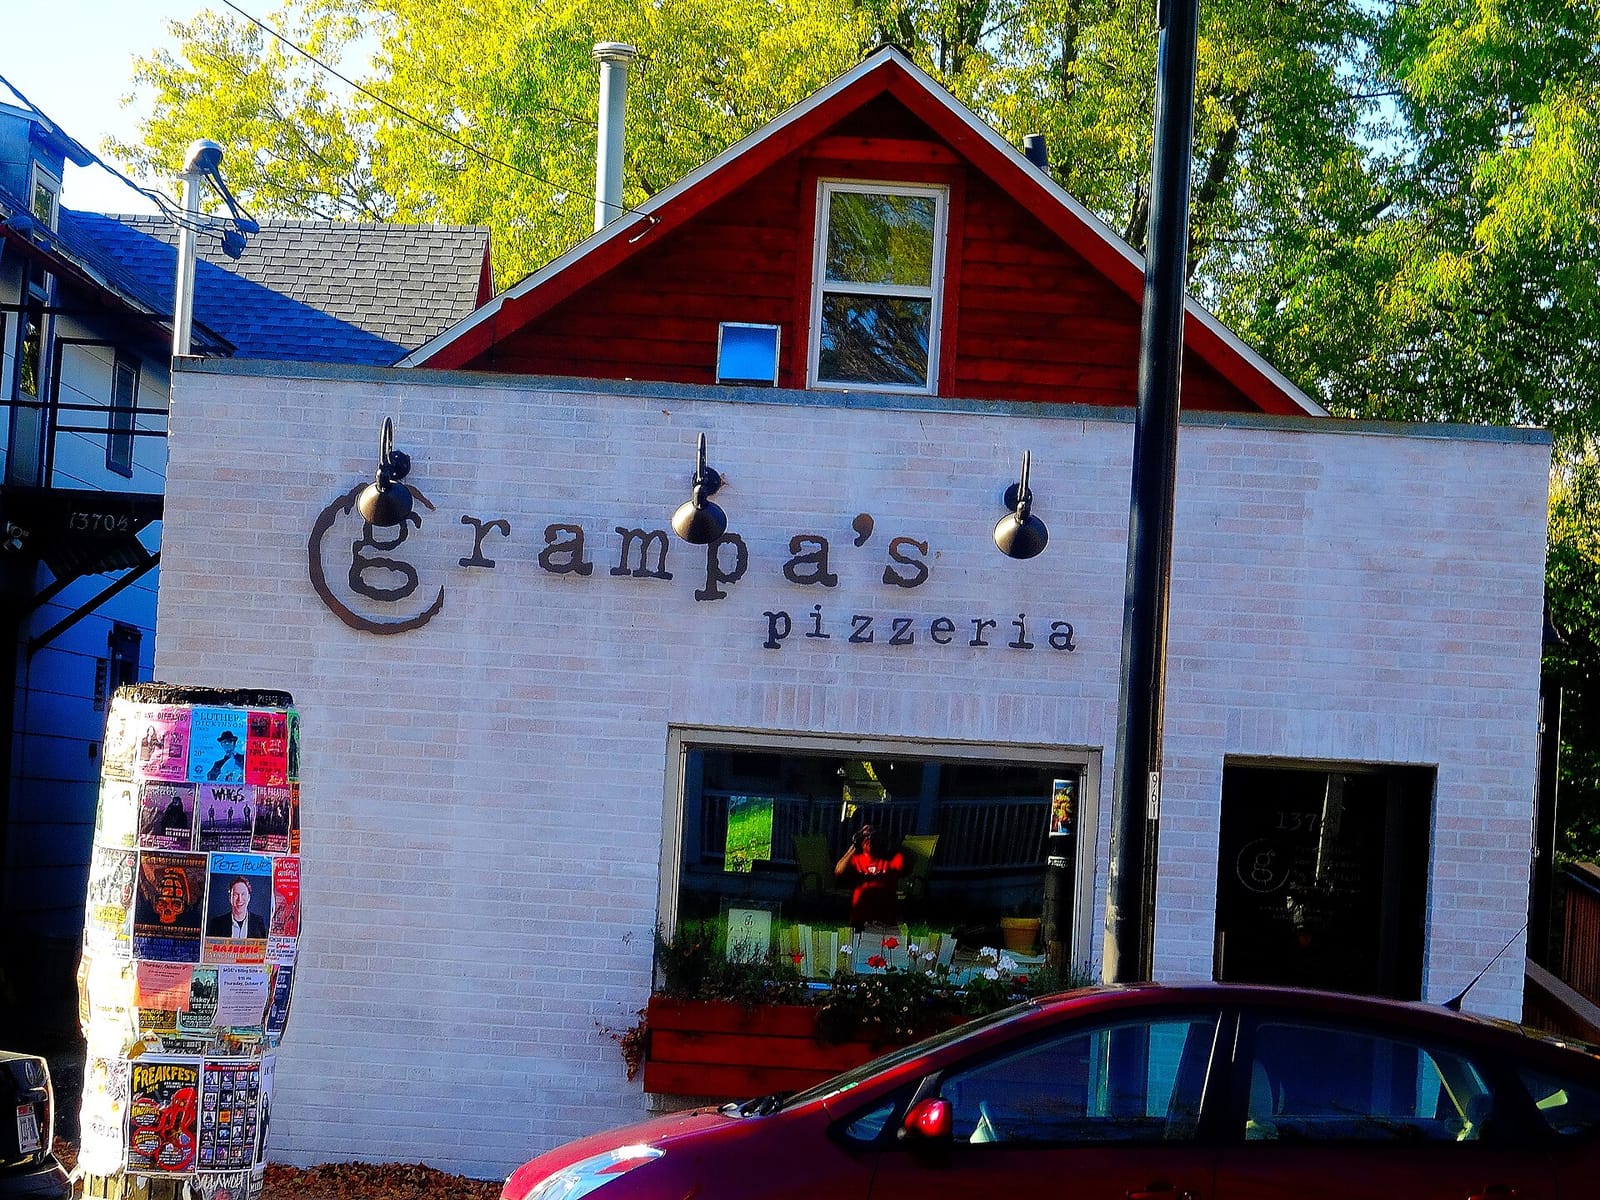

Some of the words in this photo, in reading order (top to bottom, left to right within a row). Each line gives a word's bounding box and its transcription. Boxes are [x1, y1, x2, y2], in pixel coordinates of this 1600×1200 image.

[309, 488, 929, 632] grampa's
[763, 604, 1076, 652] pizzeria
[195, 720, 244, 729] DICKINSON
[200, 712, 240, 722] LUTHER
[211, 787, 246, 804] WHIGS
[212, 854, 239, 872] PETE
[133, 1065, 198, 1093] FREAKFEST
